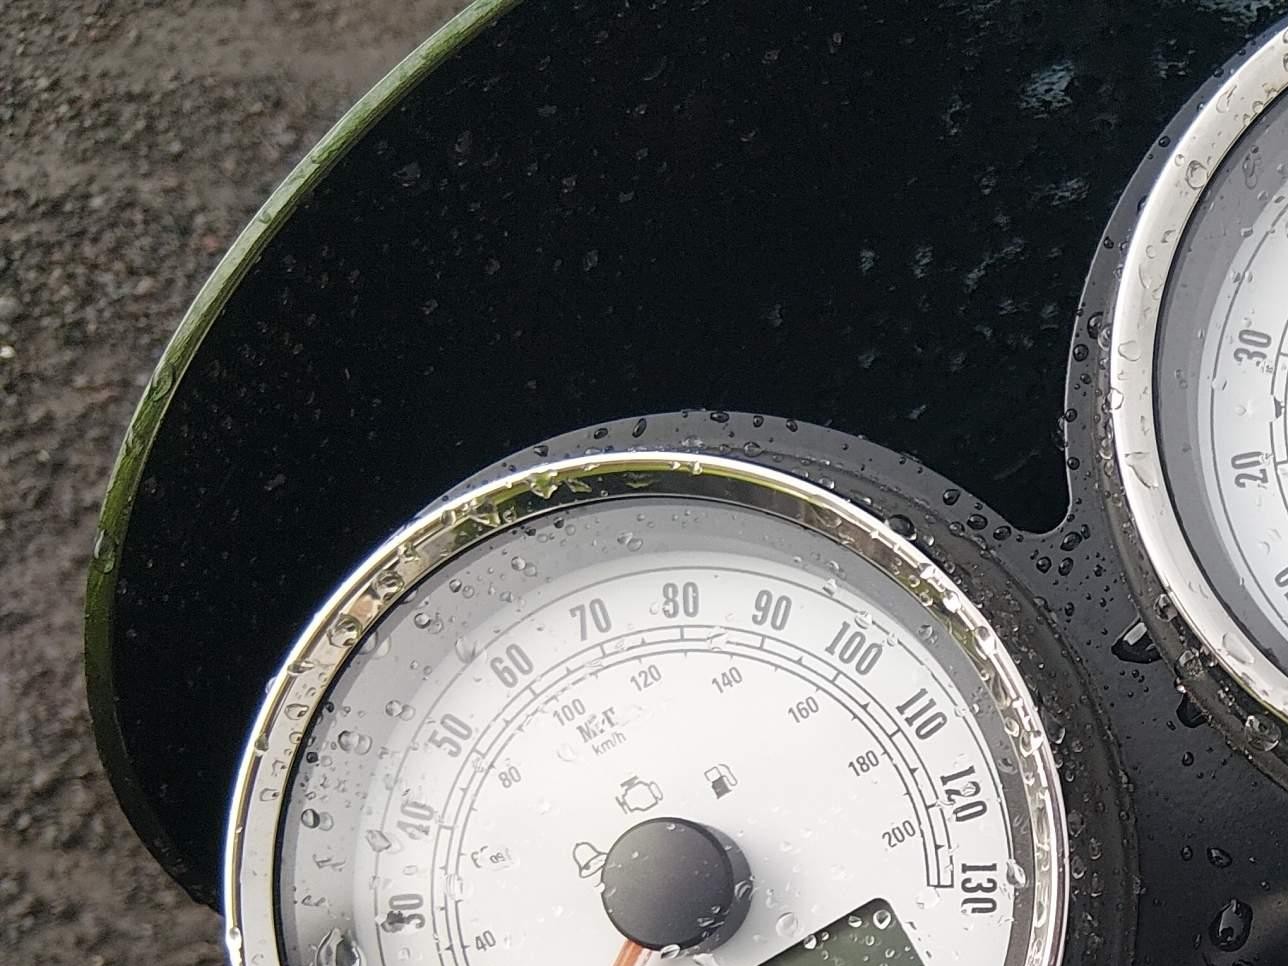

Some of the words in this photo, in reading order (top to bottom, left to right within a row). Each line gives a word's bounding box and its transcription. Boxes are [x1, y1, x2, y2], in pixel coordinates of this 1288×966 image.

[1233, 329, 1272, 364] 30
[1231, 451, 1270, 489] 20
[662, 582, 699, 619] 80
[752, 589, 793, 632] 90
[569, 598, 612, 641] 70
[490, 643, 534, 689] 60
[825, 622, 883, 676] 100
[629, 664, 662, 692] 120
[711, 666, 743, 694] 140
[552, 698, 586, 728] 100
[787, 696, 819, 723] 160
[896, 688, 948, 740] 110
[428, 713, 473, 758] 50
[498, 766, 522, 789] 80
[848, 750, 880, 777] 180
[940, 765, 988, 822] 120
[397, 801, 434, 840] 40
[882, 820, 917, 849] 200
[960, 863, 997, 914] 130
[474, 929, 497, 952] 40
